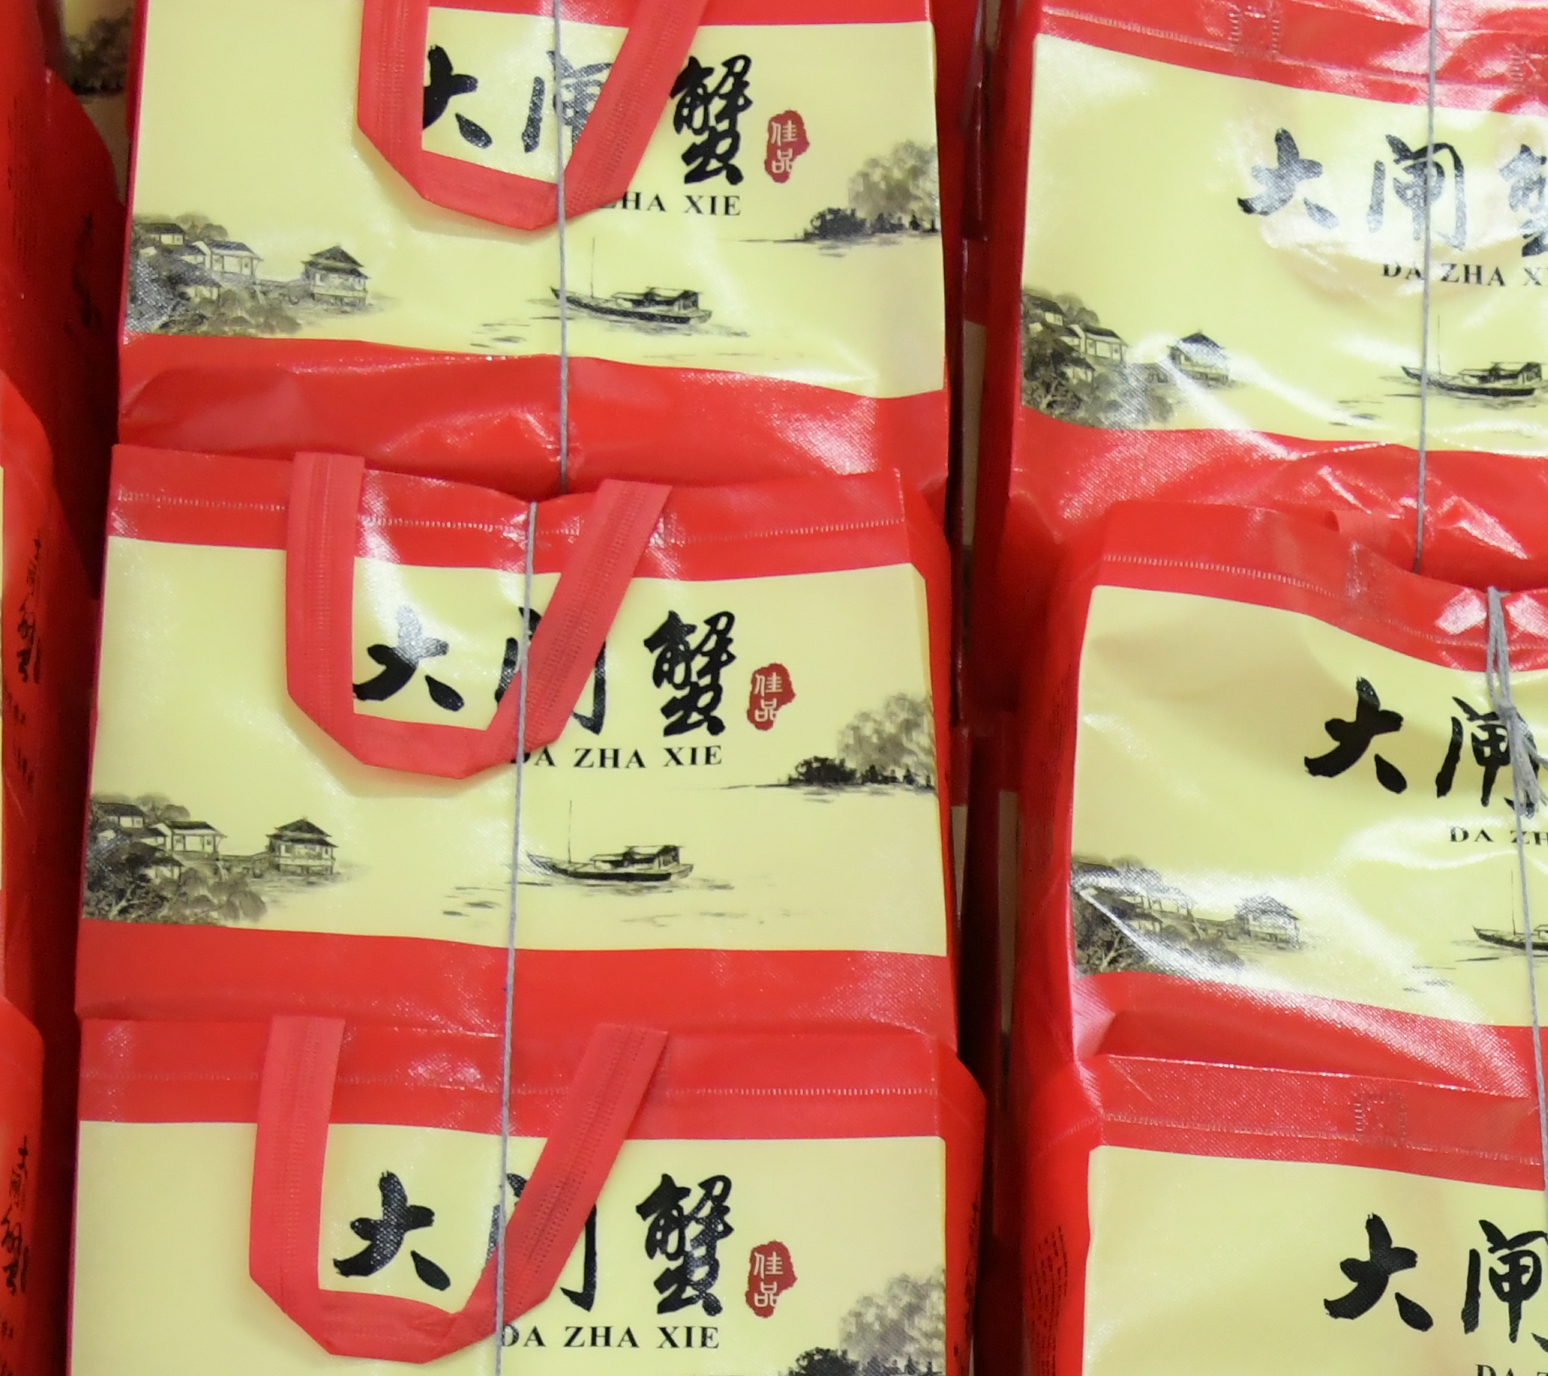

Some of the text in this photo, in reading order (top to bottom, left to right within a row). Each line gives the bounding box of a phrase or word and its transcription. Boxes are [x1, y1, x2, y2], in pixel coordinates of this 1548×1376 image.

[771, 119, 804, 178] 佳品
[681, 191, 743, 216] XIE
[754, 670, 787, 725] 佳品
[572, 744, 650, 769] ZHA
[663, 743, 723, 768] XIE
[1449, 825, 1499, 846] DA
[753, 1250, 783, 1310] 佳品
[498, 1325, 720, 1350] DA ZHA XIE
